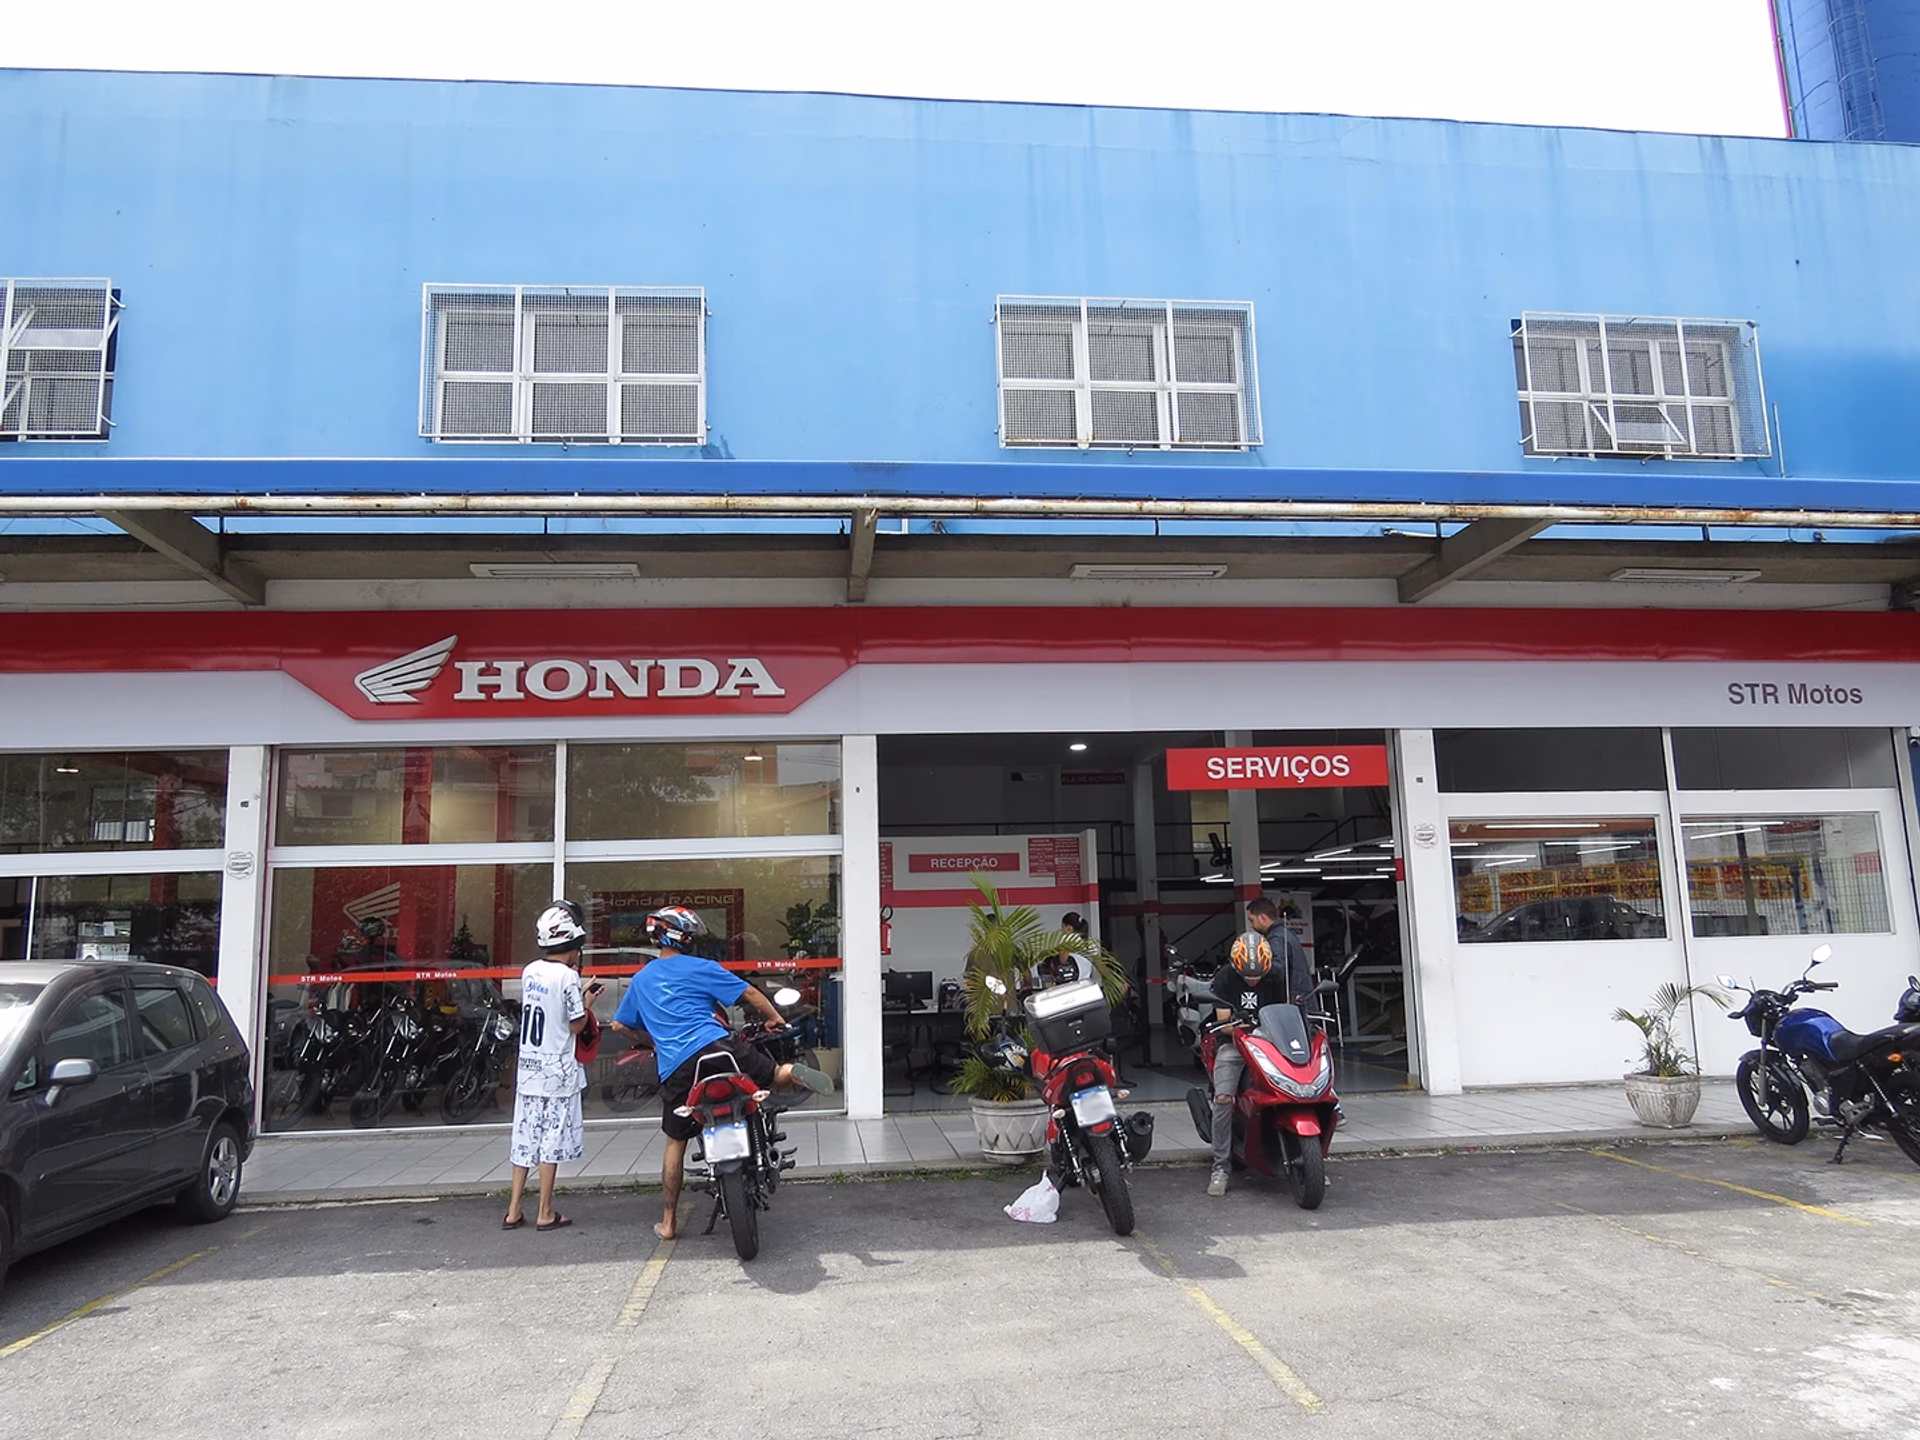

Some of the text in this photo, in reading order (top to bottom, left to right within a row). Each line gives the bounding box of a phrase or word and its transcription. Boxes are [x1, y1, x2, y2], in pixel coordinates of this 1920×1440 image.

[453, 658, 786, 700] HONDA
[1728, 682, 1863, 705] STR Motos
[1206, 754, 1351, 783] SERVIÇOS
[930, 855, 998, 870] RECEPÇÃO
[669, 895, 735, 905] RACING
[416, 971, 431, 979] STR
[522, 1004, 545, 1047] 10
